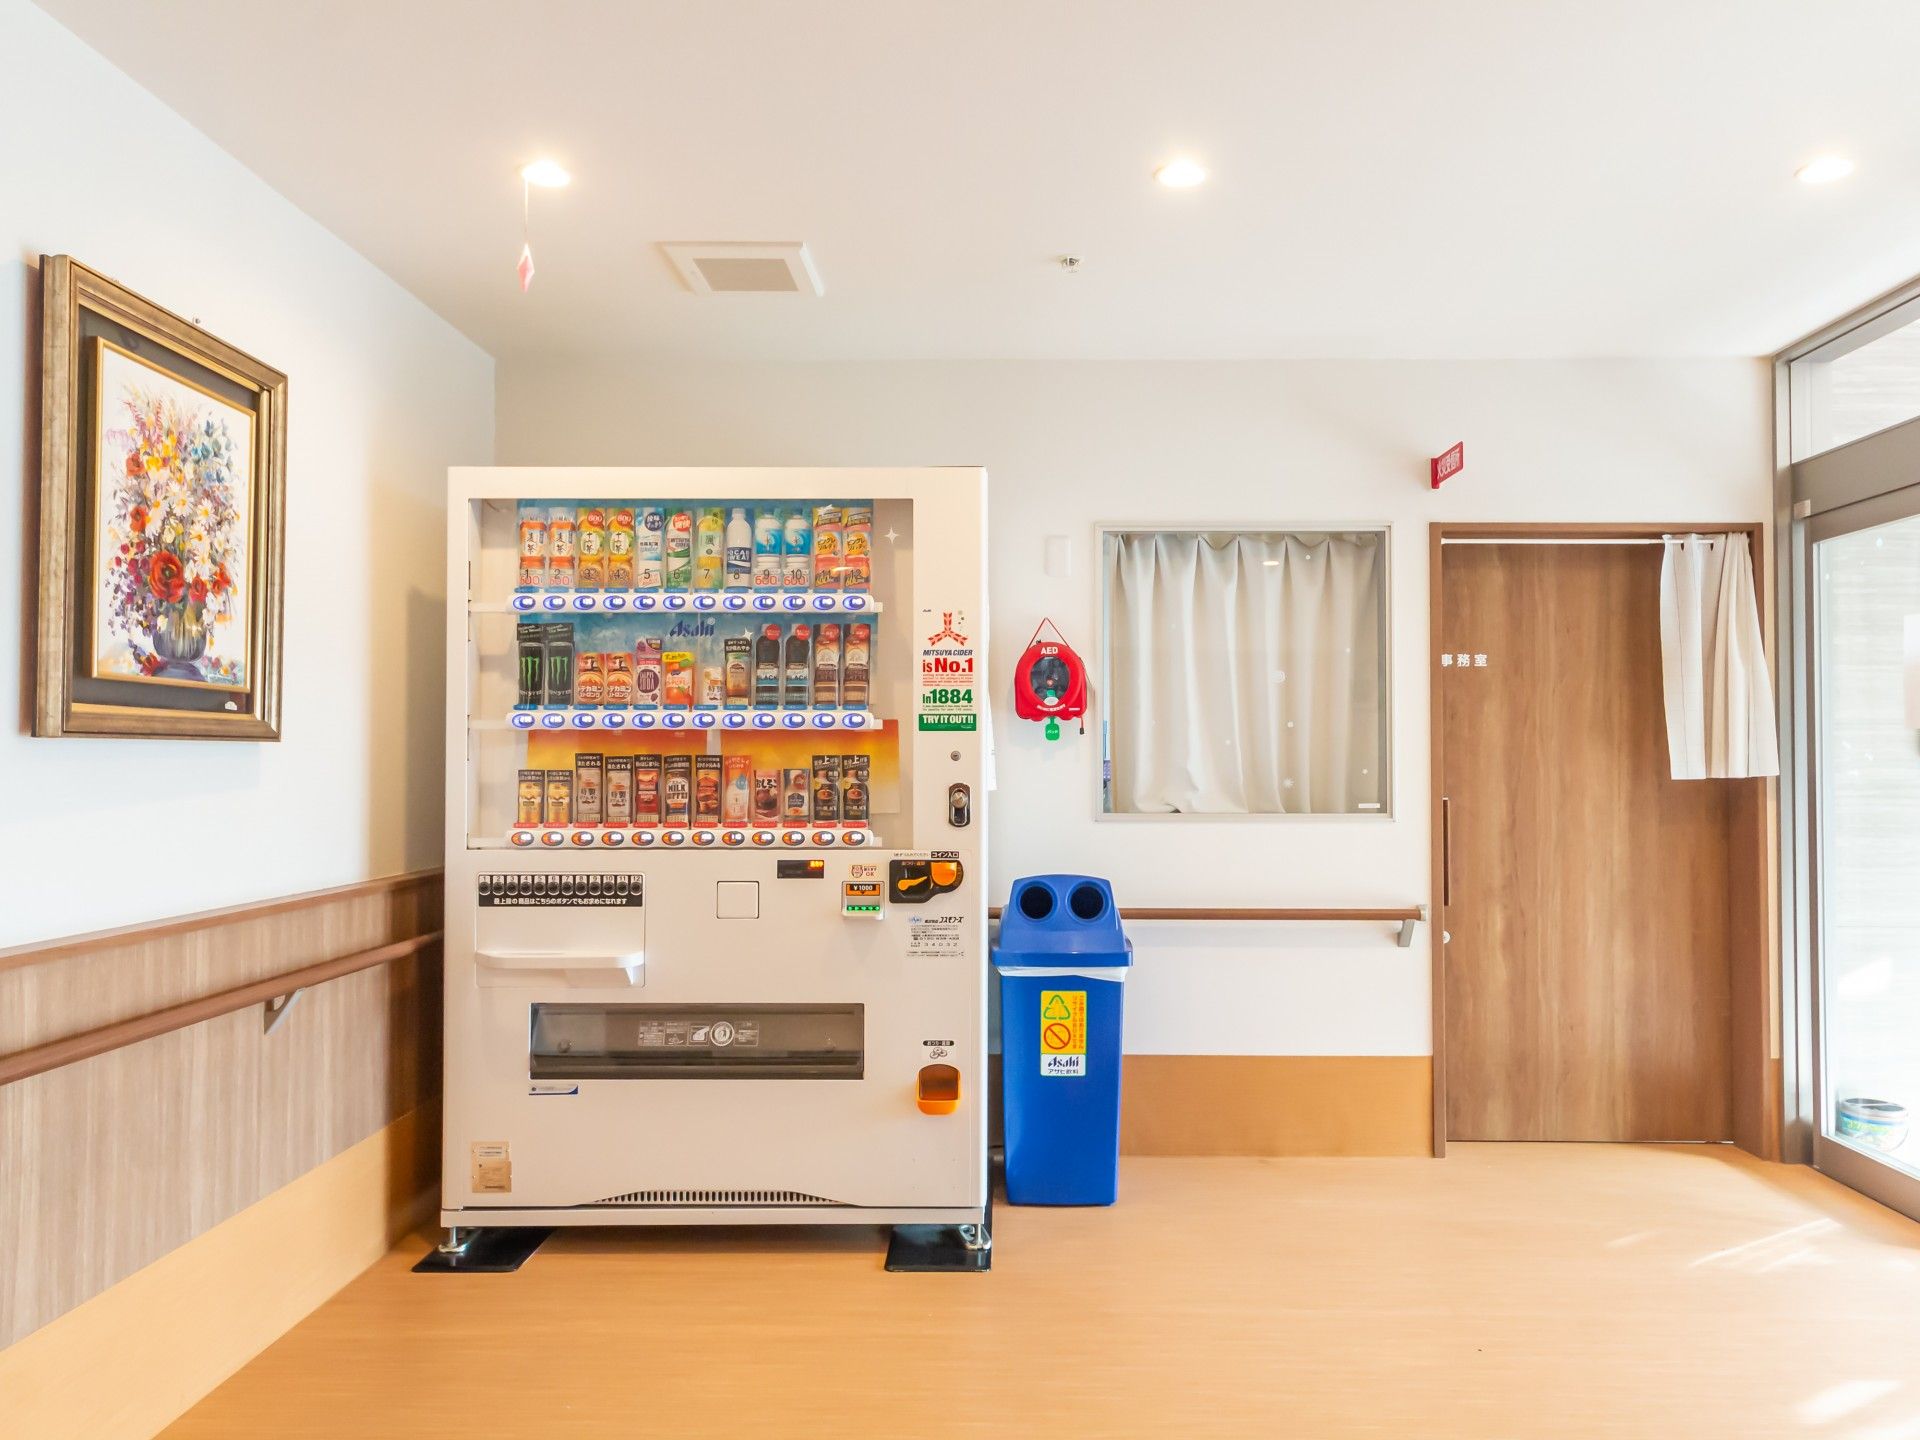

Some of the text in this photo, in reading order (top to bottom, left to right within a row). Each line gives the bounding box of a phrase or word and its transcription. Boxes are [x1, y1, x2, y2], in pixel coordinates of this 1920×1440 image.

[669, 620, 715, 638] Asahi
[1041, 646, 1058, 655] AED
[923, 657, 973, 673] is No.1
[1441, 653, 1488, 667] 事務室
[930, 688, 973, 704] 1884
[923, 715, 939, 724] TRY
[940, 715, 949, 724] IT
[1048, 1056, 1079, 1067] Asahi
